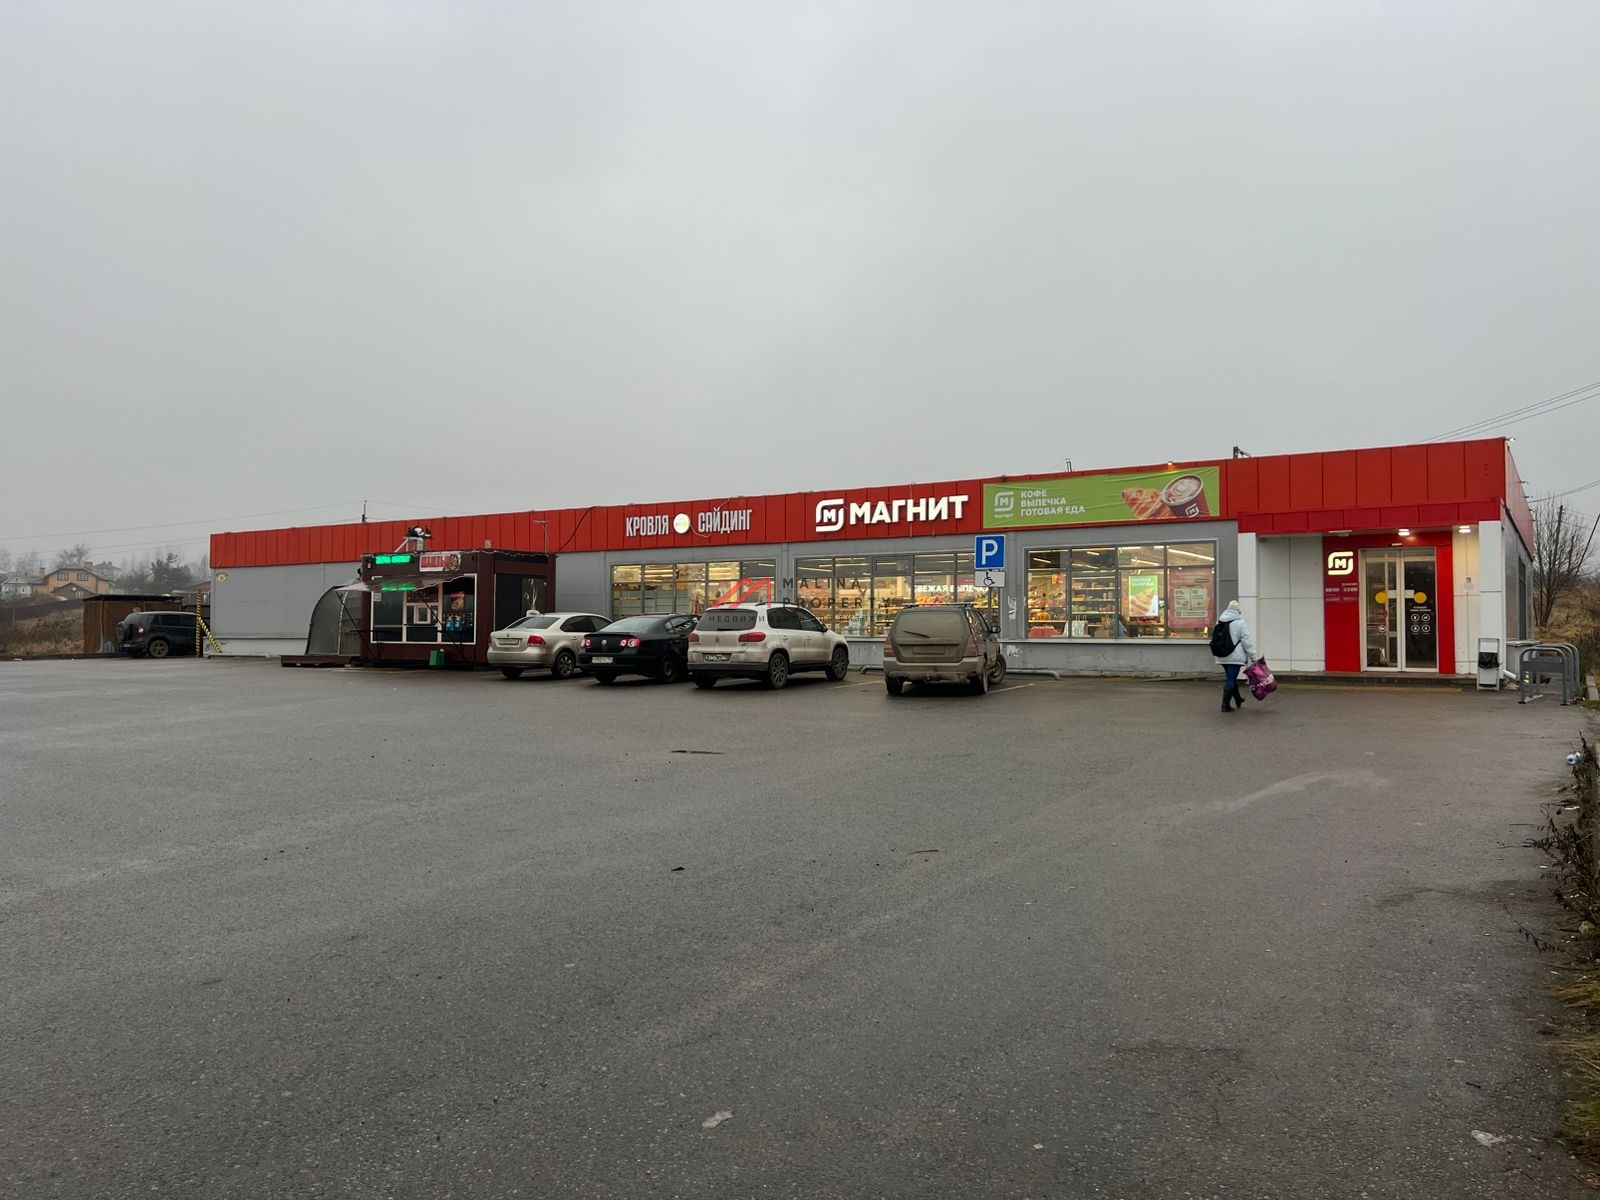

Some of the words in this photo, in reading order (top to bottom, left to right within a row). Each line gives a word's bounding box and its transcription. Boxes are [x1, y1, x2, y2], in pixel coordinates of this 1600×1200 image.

[1021, 489, 1047, 498] КОФЕ
[1021, 497, 1067, 508] ВЫПЕЧКА
[850, 495, 969, 525] МАГНИТ
[1021, 507, 1063, 517] ГОТОВАЯ
[1065, 505, 1085, 515] ЕДА
[626, 514, 669, 537] КРОВЛЯ
[698, 507, 753, 534] САЙДИНГ
[982, 539, 998, 565] P
